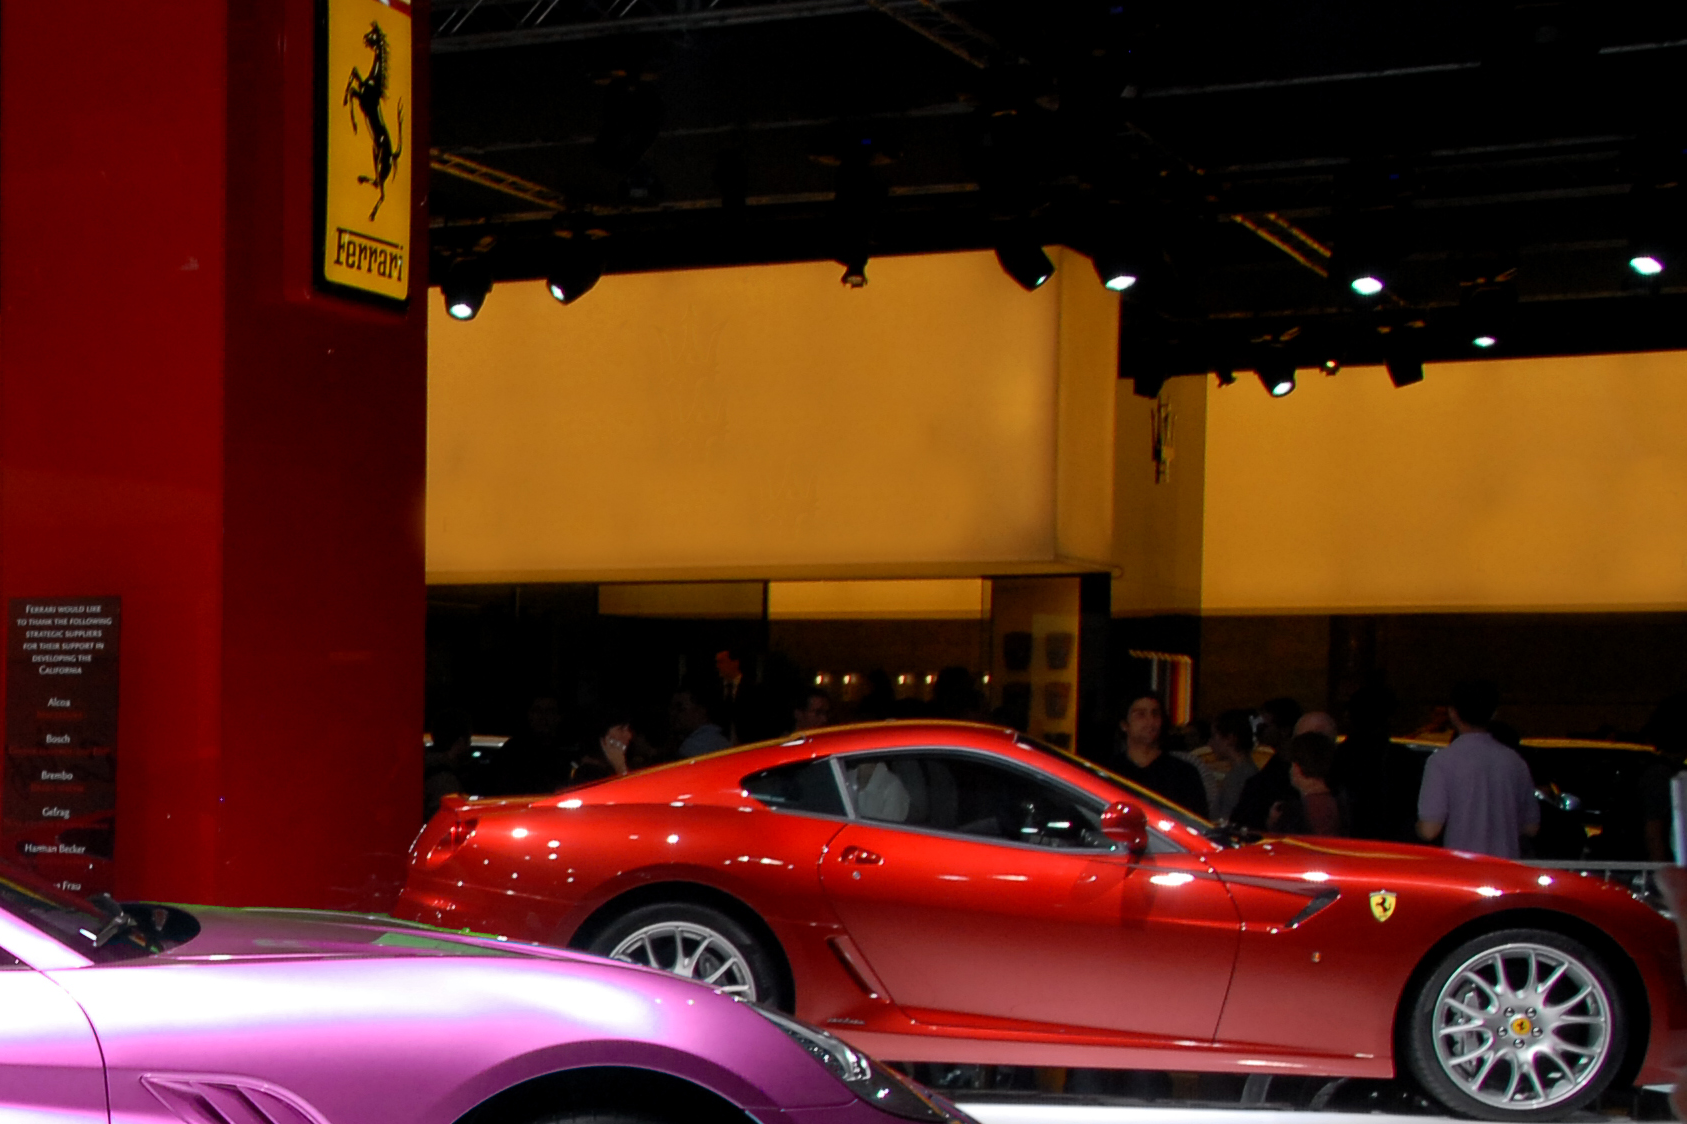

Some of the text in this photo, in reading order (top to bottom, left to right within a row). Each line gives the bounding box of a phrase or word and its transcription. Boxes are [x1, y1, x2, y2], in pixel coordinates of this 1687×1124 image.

[333, 227, 404, 282] Ferrari
[45, 733, 71, 744] Bosch
[41, 769, 74, 781] Brembo
[59, 844, 86, 855] Becker
